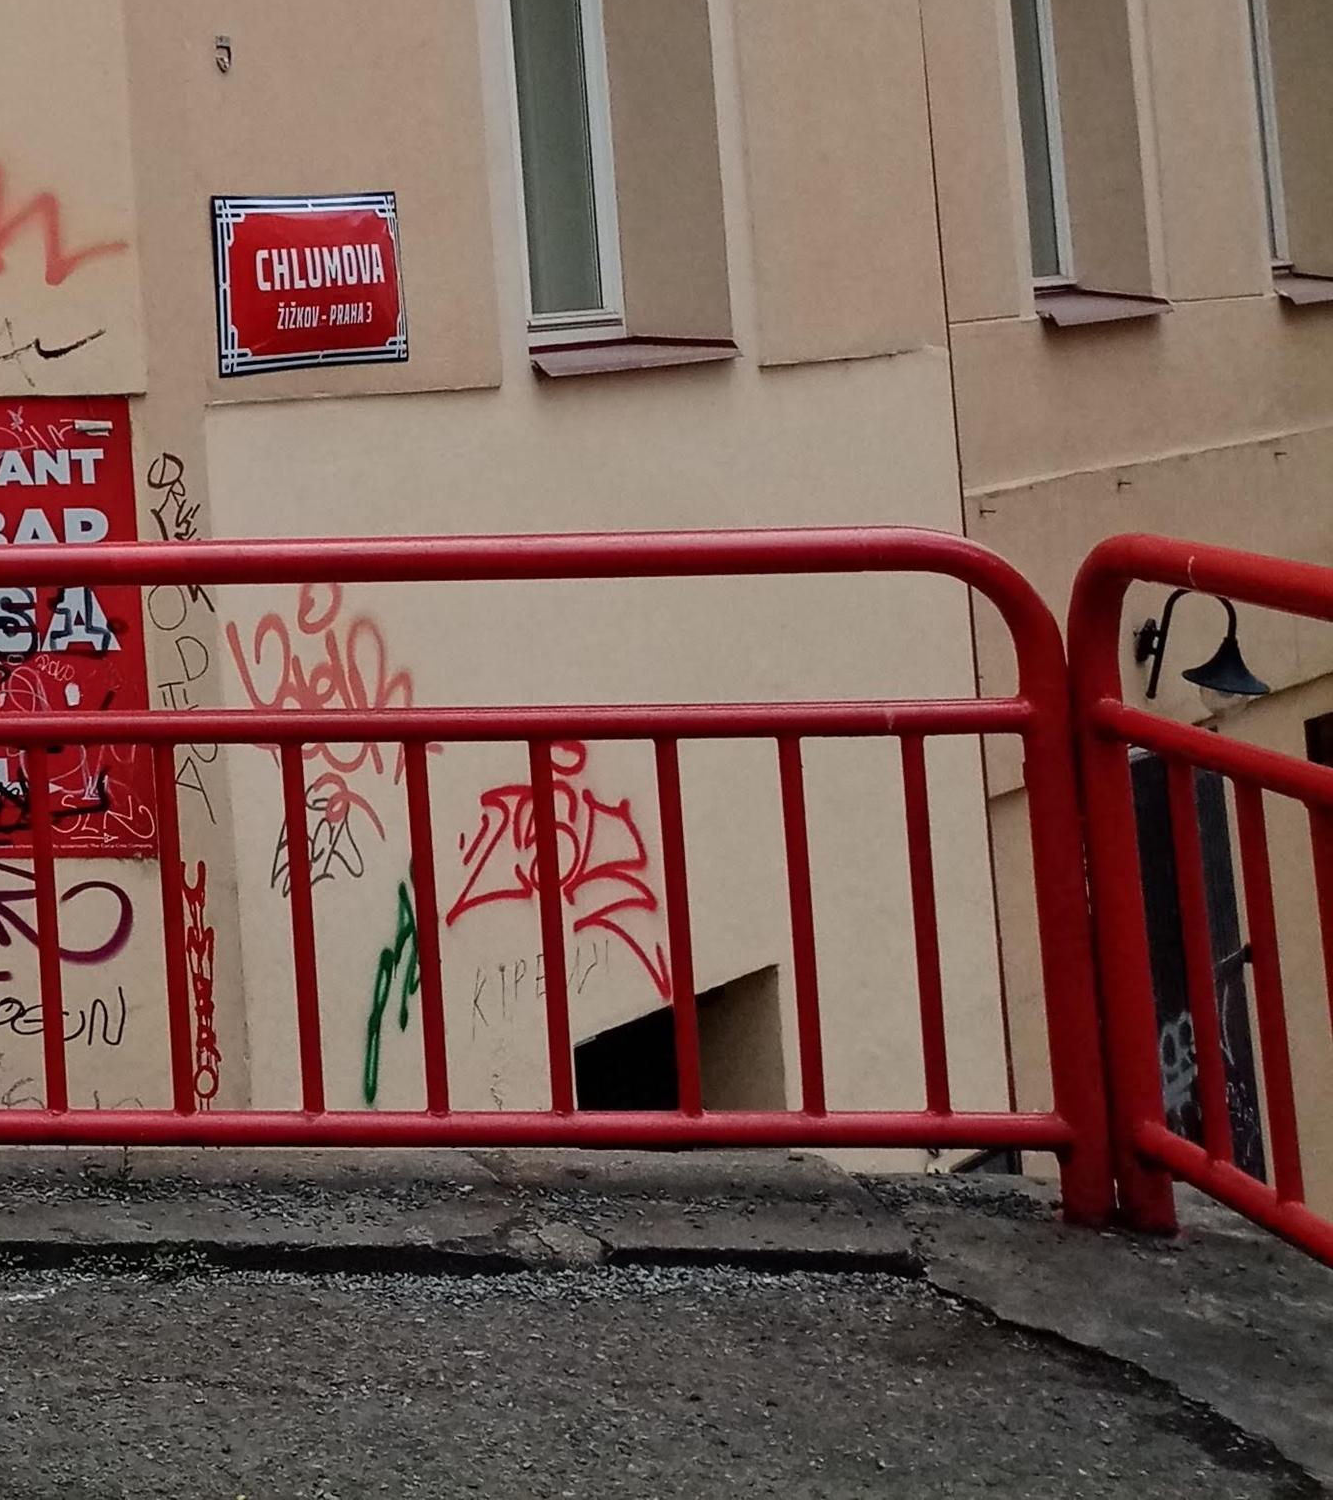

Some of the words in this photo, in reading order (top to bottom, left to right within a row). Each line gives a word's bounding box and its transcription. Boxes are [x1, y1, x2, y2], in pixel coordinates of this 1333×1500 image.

[255, 243, 385, 292] CHLUMOVA
[276, 301, 319, 330] ŽIŽKOV
[329, 303, 364, 327] PRAHA
[366, 302, 373, 323] 3
